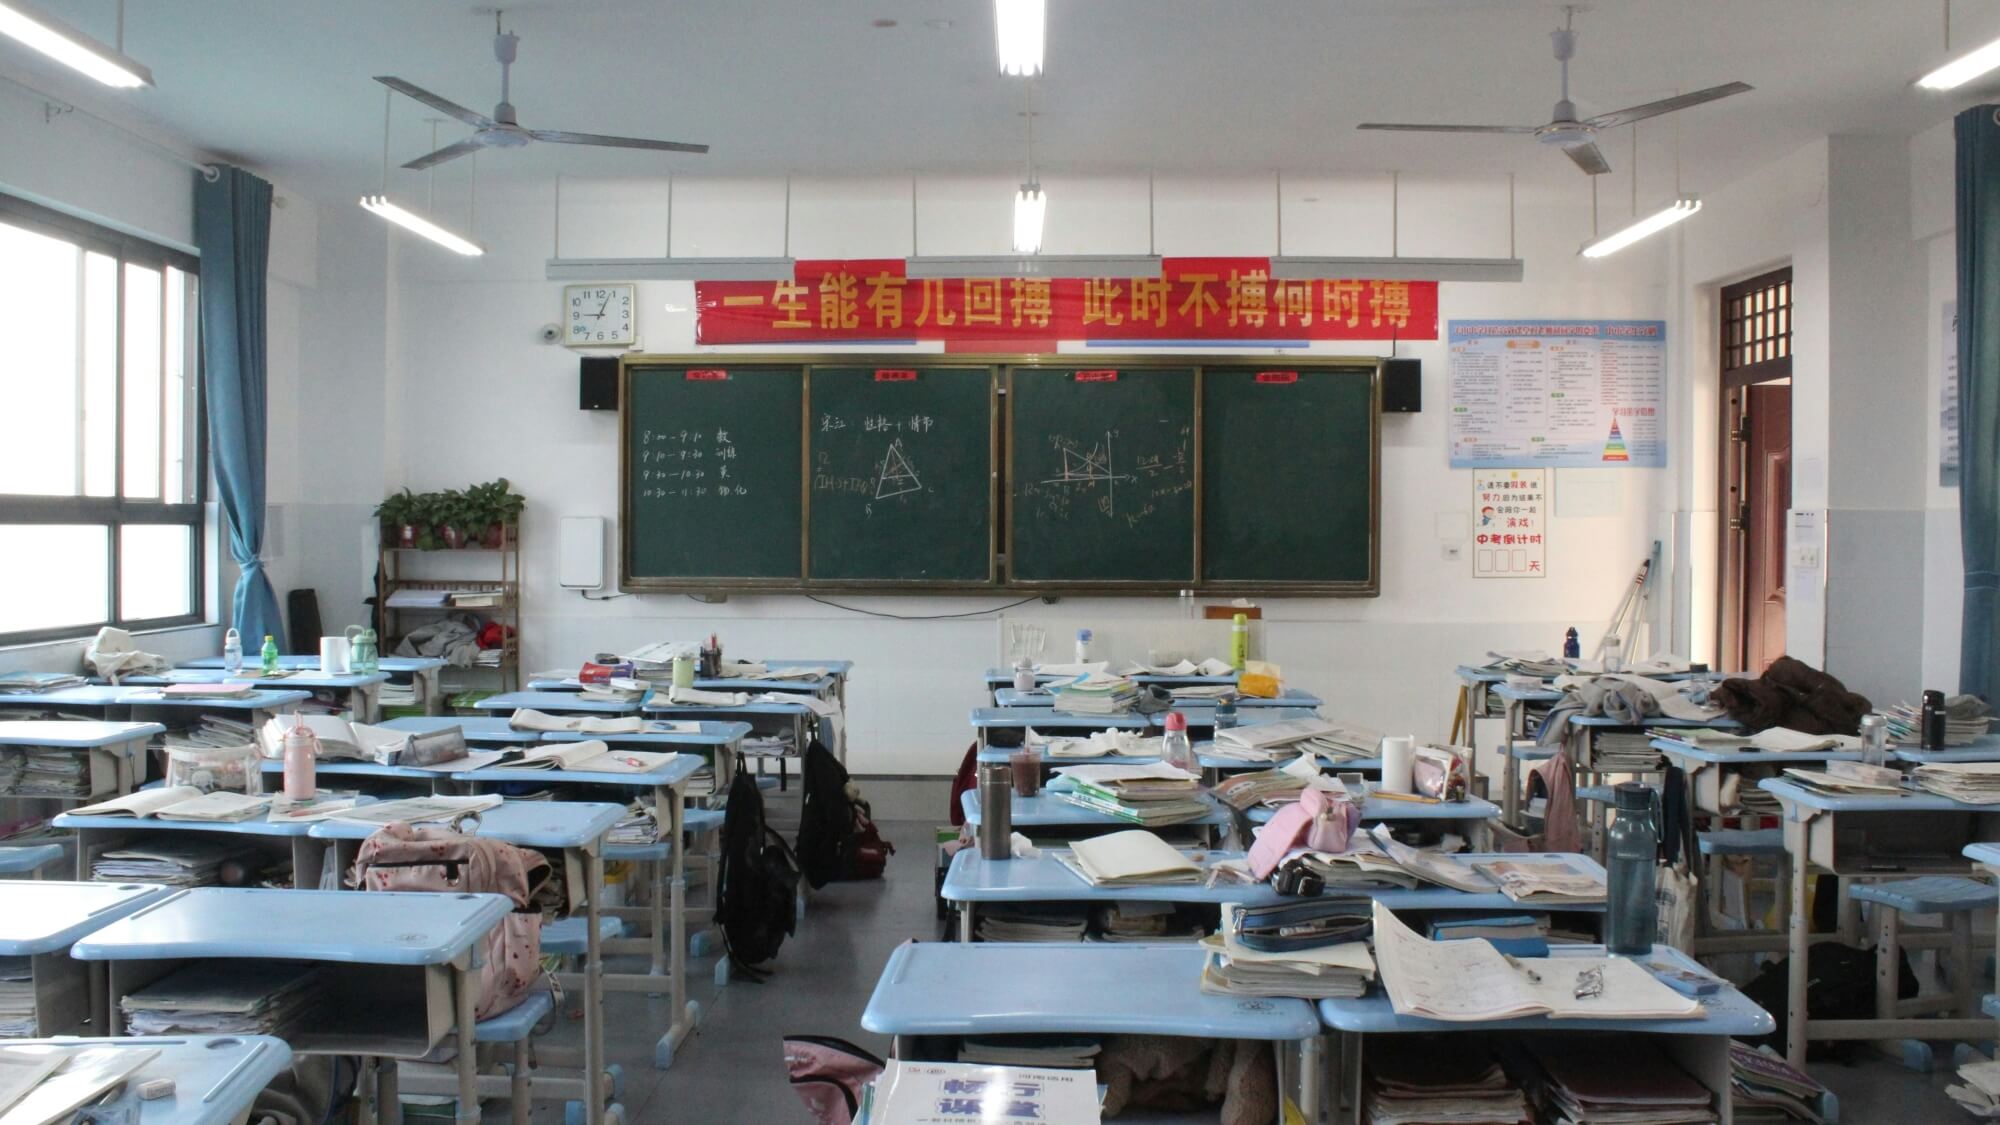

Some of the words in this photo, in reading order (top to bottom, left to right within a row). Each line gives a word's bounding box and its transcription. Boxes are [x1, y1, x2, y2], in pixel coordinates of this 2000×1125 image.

[584, 291, 591, 299] 11
[596, 290, 606, 298] 12
[573, 298, 581, 306] 10
[622, 297, 629, 305] 2
[573, 312, 580, 320] 9
[622, 311, 629, 319] 3
[573, 326, 580, 334] 8
[622, 323, 629, 331] 4
[584, 332, 591, 340] 7
[597, 332, 604, 340] 6
[611, 331, 618, 340] 5
[1476, 534, 1542, 544] 中考倒计时
[1529, 561, 1541, 571] 天
